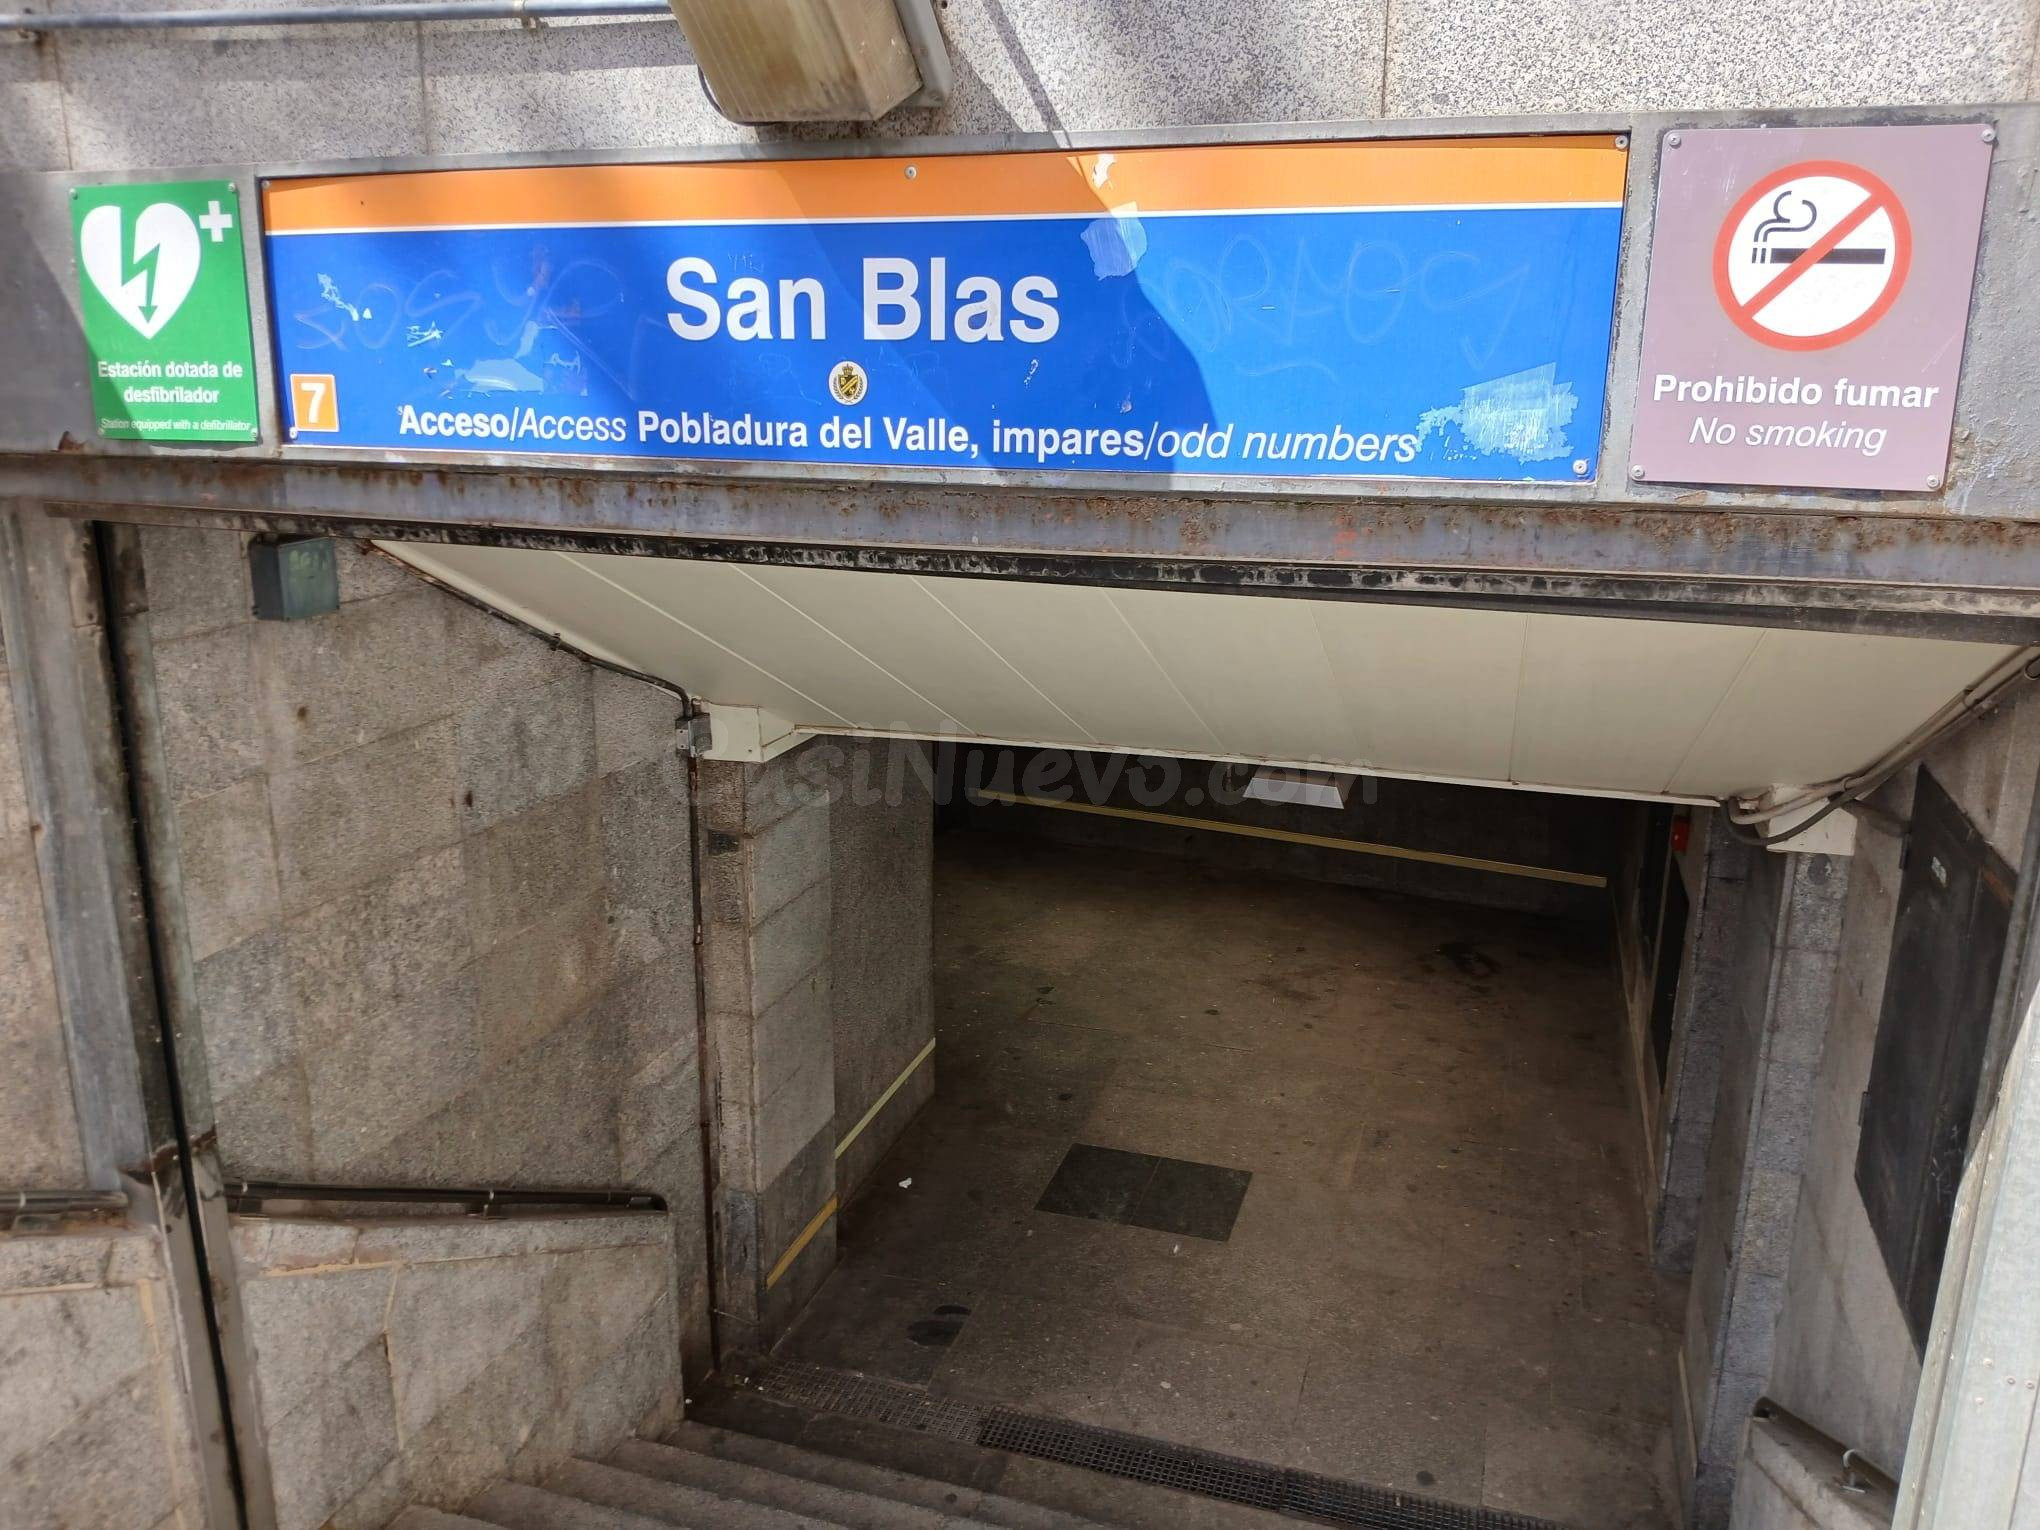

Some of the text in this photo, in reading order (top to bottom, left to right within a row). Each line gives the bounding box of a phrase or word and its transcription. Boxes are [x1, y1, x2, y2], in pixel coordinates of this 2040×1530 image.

[666, 256, 827, 342] San
[862, 256, 1061, 344] Blas
[98, 360, 243, 377] Estación dotada de
[124, 386, 220, 403] desfibrilador
[300, 382, 326, 425] 7
[1654, 374, 1939, 408] Prohibido fumar
[400, 406, 1418, 464] Acceso/Access Pobladura del Valle, impares/odd numbers
[1689, 417, 1887, 456] No smoking
